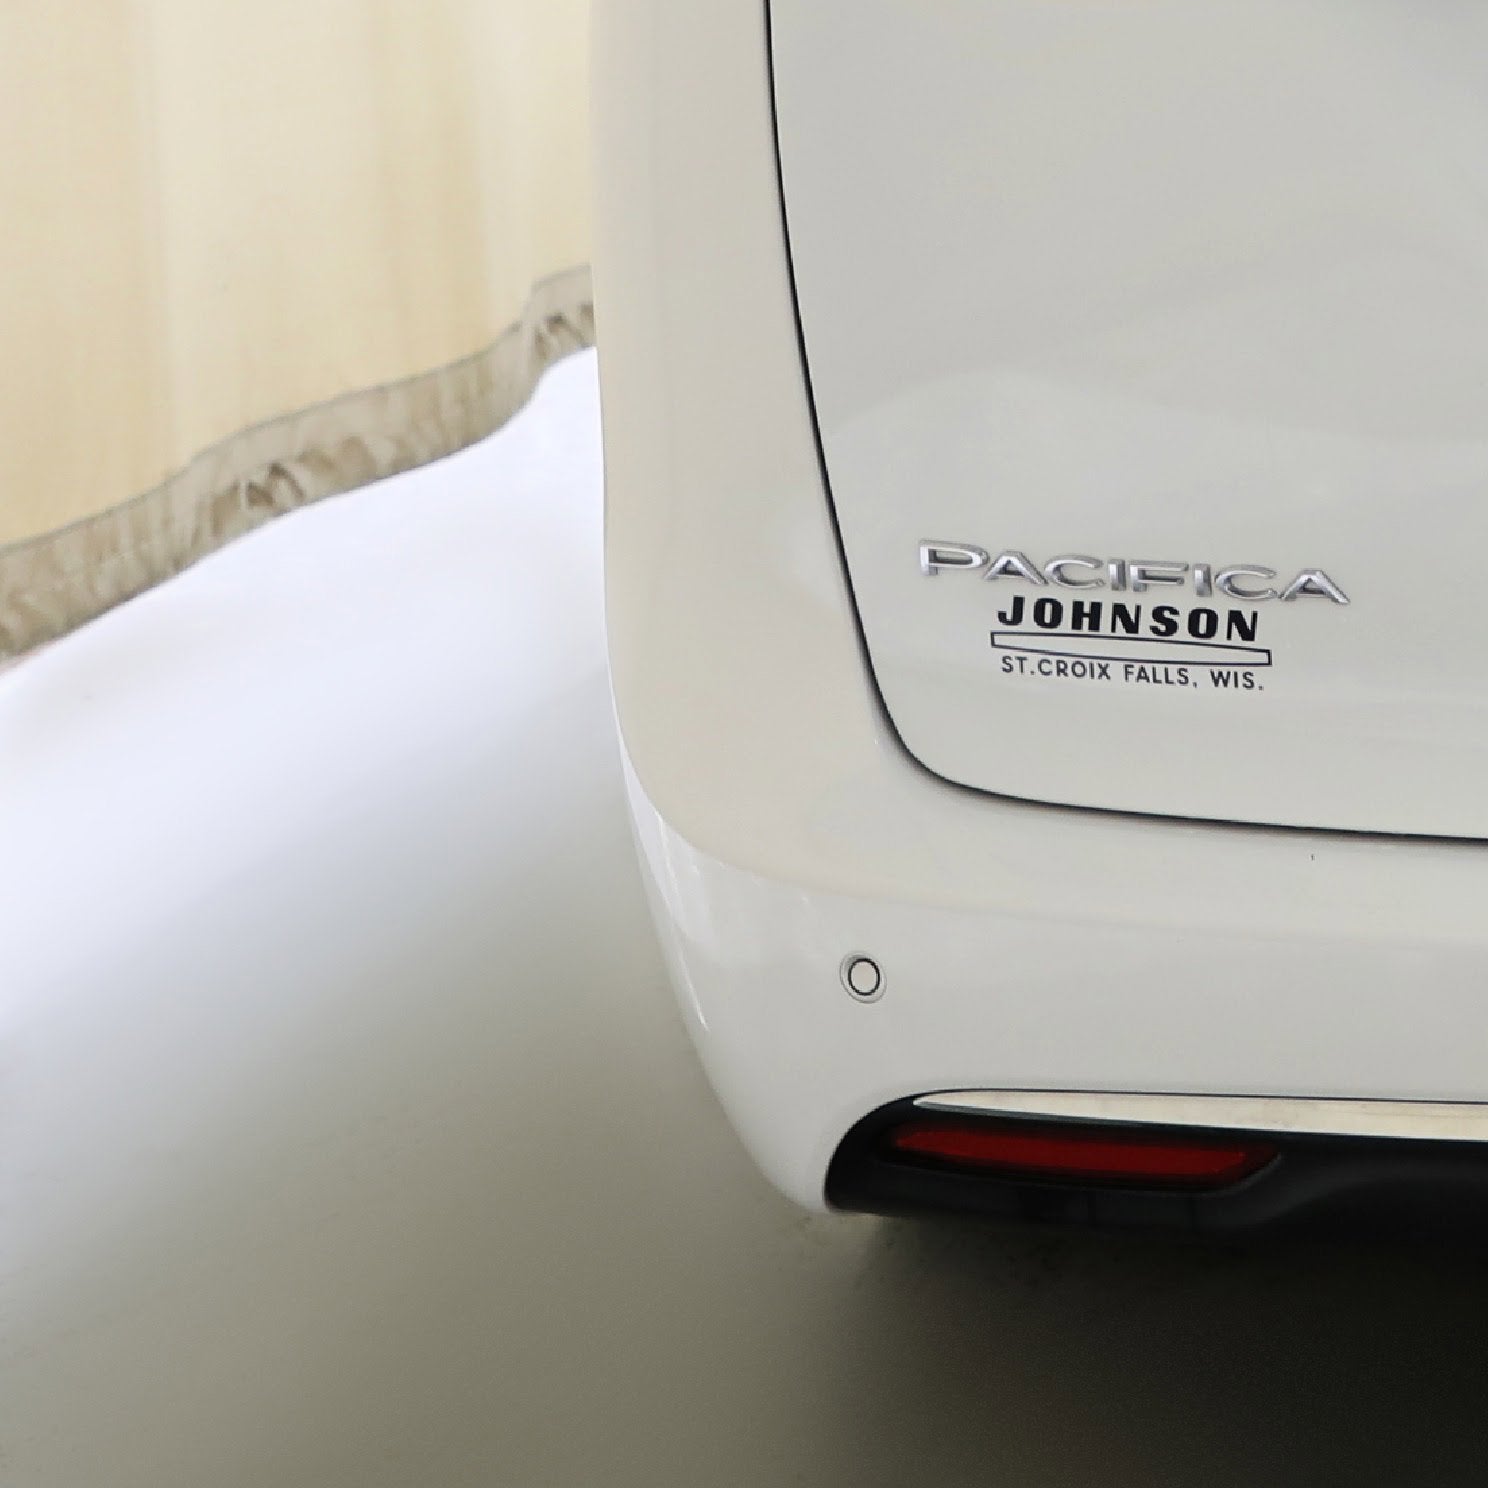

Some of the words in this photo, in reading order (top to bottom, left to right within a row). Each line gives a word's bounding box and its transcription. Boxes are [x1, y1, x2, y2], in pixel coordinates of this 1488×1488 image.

[918, 538, 1352, 606] PACIFICA
[997, 595, 1260, 642] JOHNSON
[1124, 663, 1198, 689] FALLS,
[1210, 668, 1265, 692] WIS.
